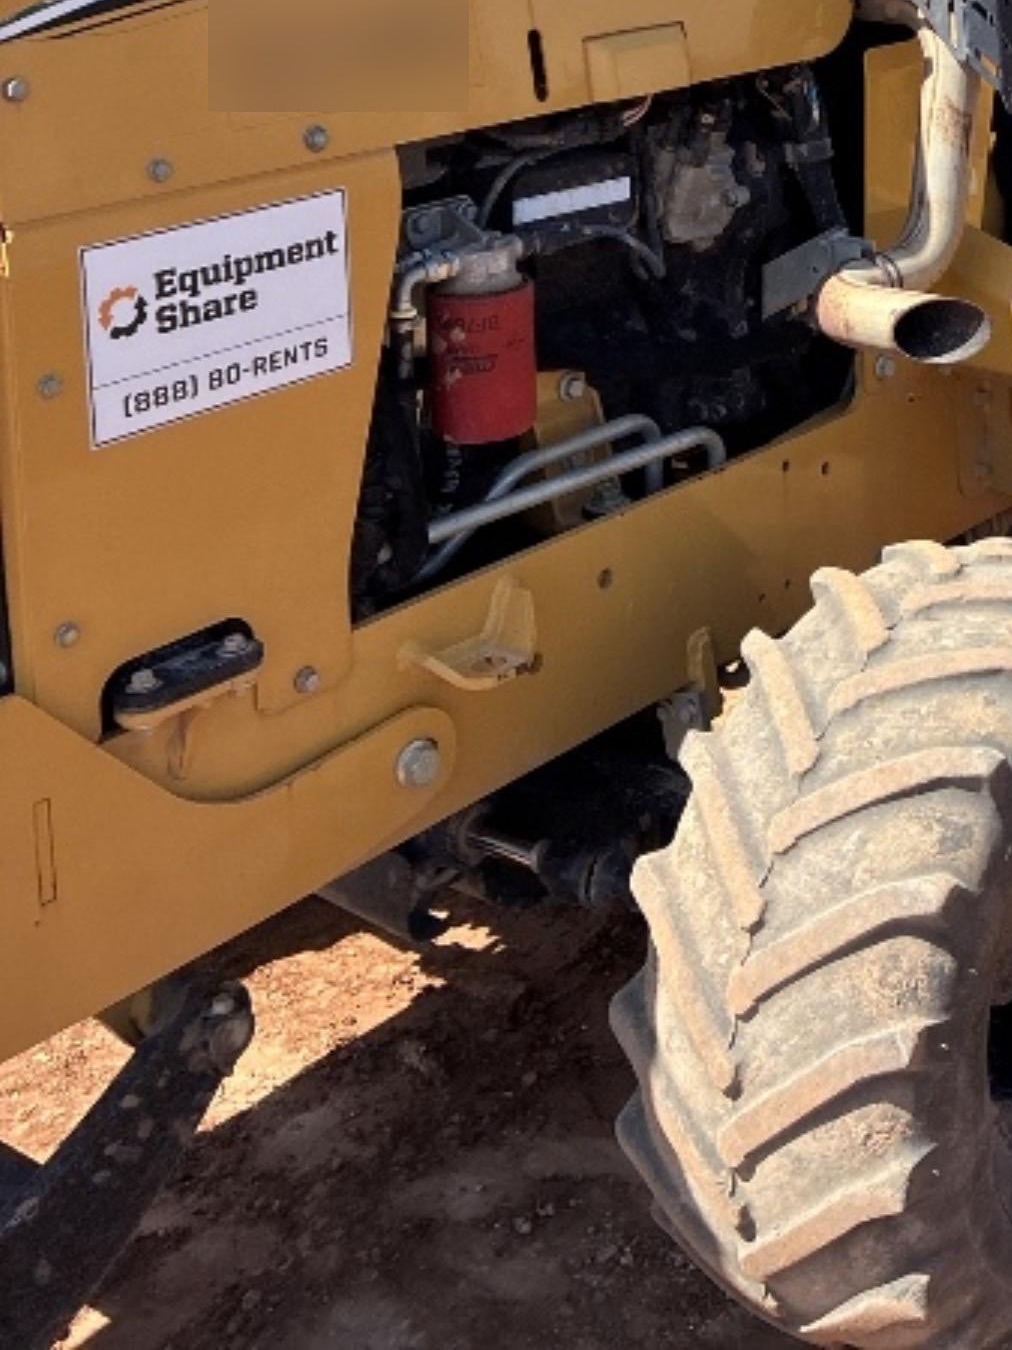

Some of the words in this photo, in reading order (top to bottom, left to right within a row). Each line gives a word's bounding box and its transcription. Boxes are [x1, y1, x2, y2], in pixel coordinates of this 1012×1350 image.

[153, 230, 338, 301] Equipment
[154, 287, 259, 334] Share
[123, 374, 199, 417] (888)
[207, 337, 329, 390] 80-RENTS
